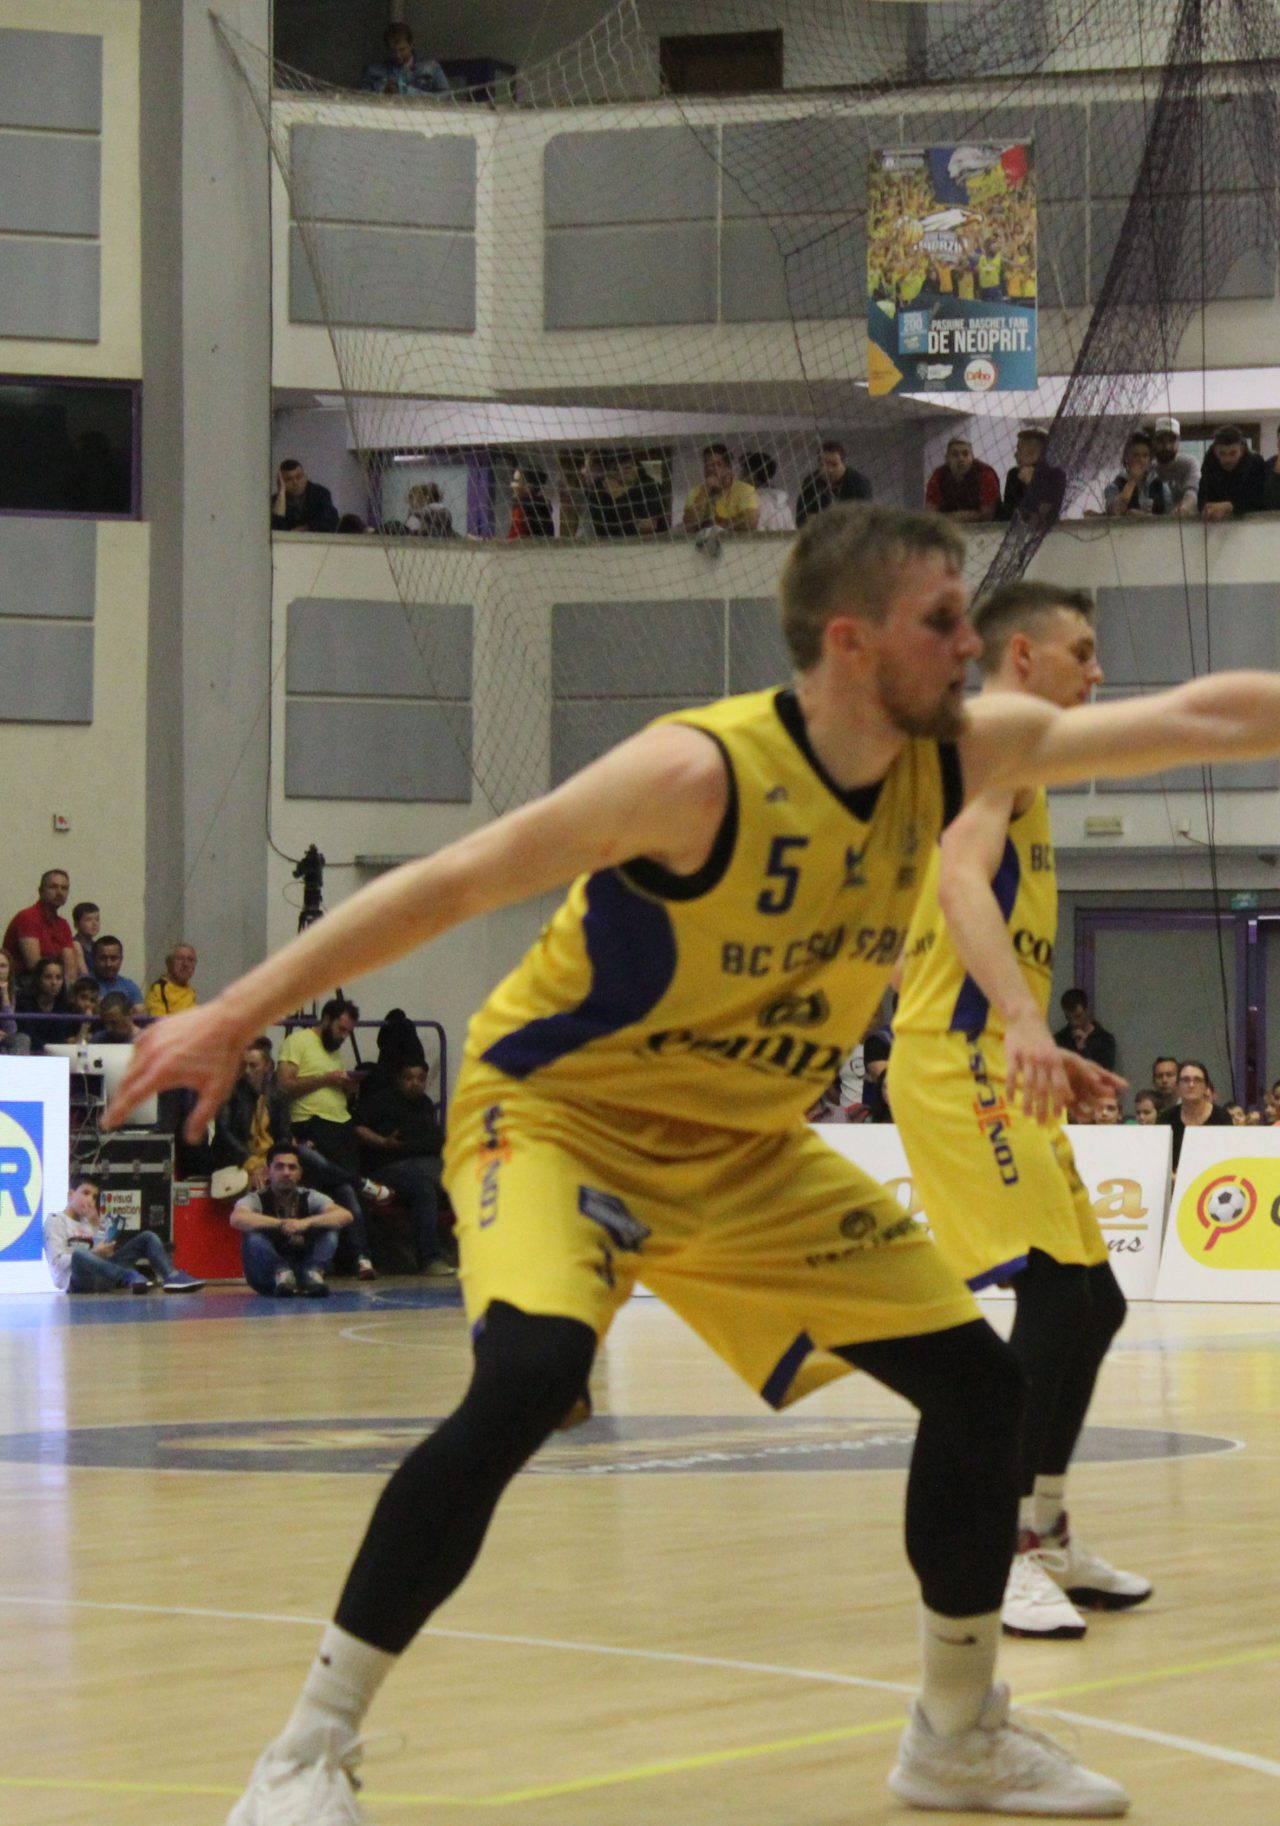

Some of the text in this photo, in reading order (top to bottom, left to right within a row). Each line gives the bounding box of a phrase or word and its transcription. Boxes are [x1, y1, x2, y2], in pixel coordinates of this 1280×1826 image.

[928, 330, 950, 354] DE
[757, 834, 810, 916] 5
[722, 940, 772, 978] BC
